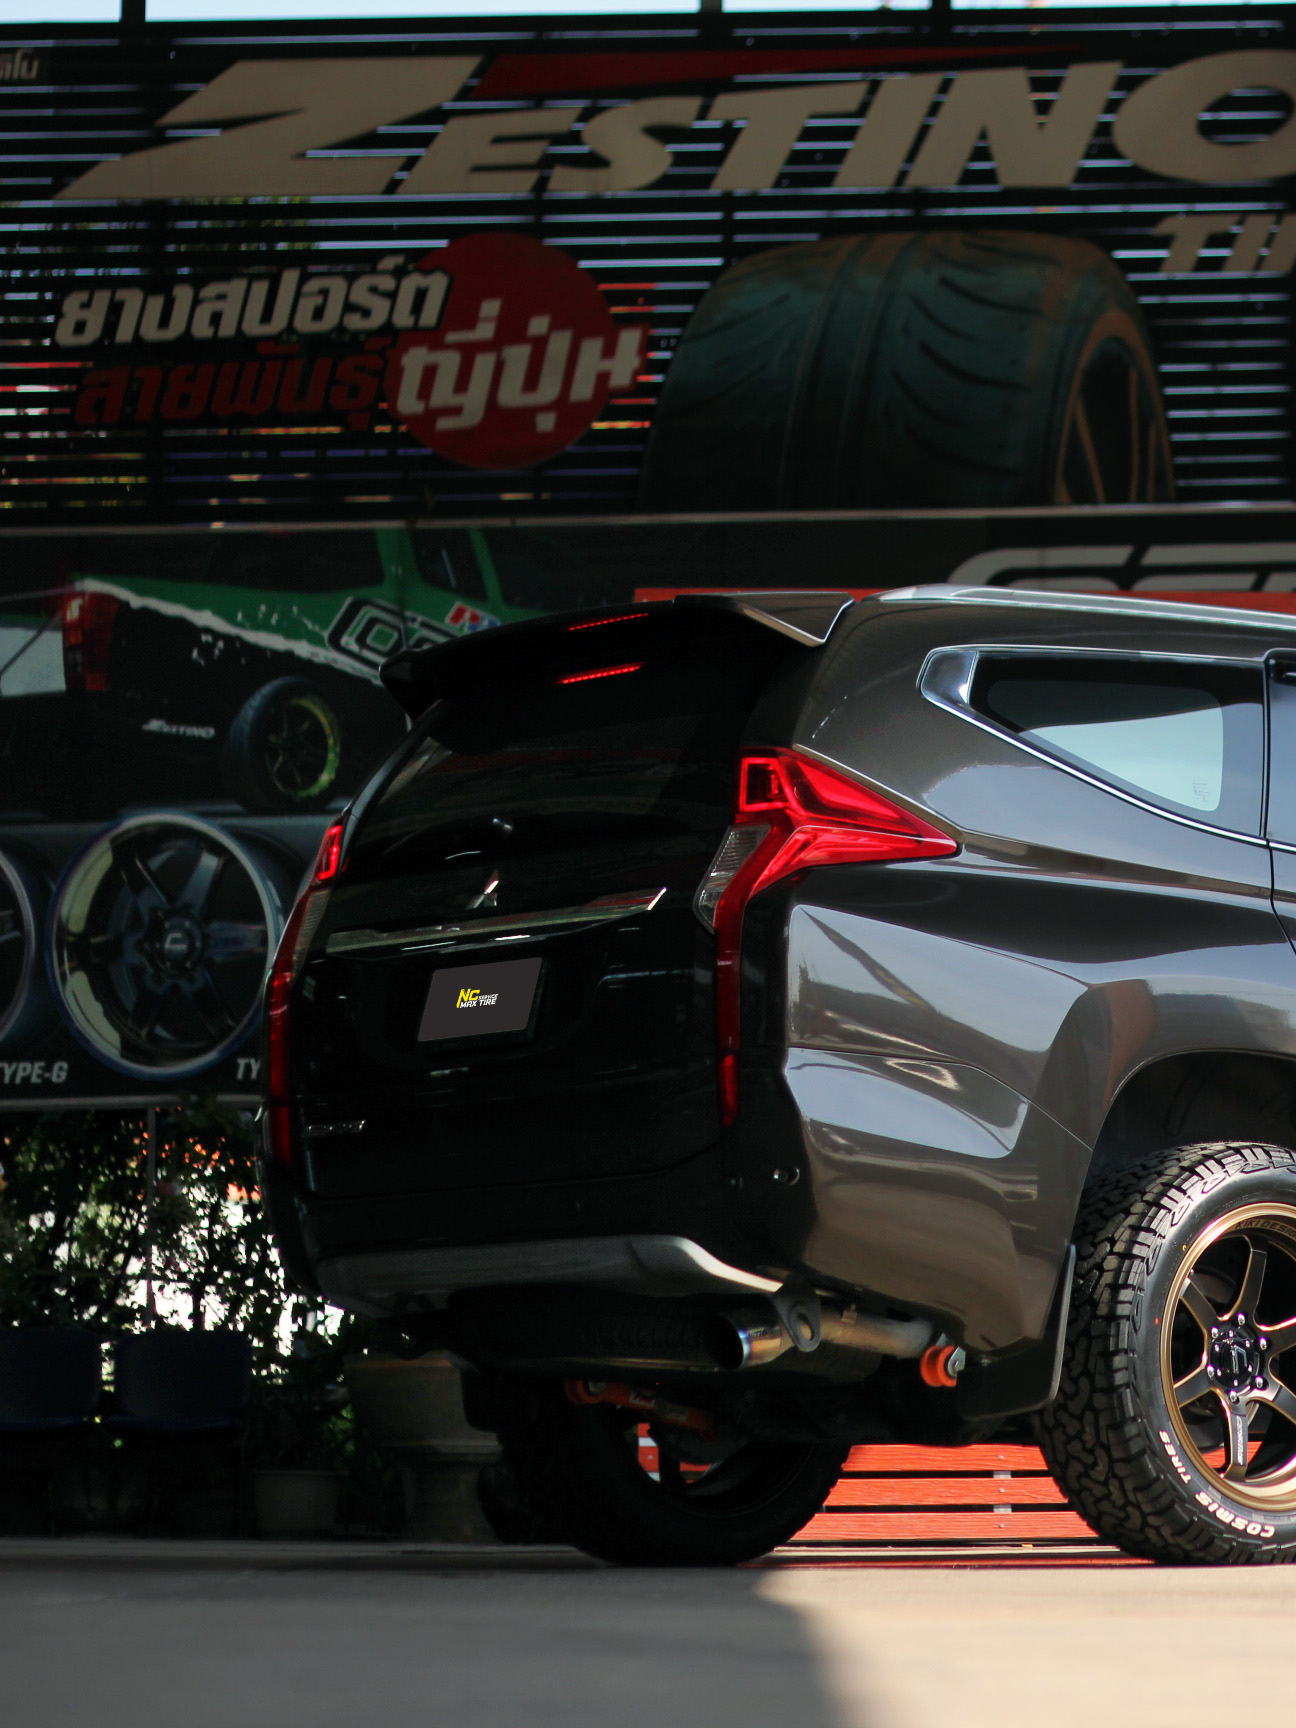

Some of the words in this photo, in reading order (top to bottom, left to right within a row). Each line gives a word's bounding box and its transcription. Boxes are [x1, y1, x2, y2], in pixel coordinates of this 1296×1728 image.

[54, 254, 450, 348] ยางสปอร์ต
[1159, 1430, 1192, 1485] TIRES
[1195, 1491, 1276, 1538] COSMIS
